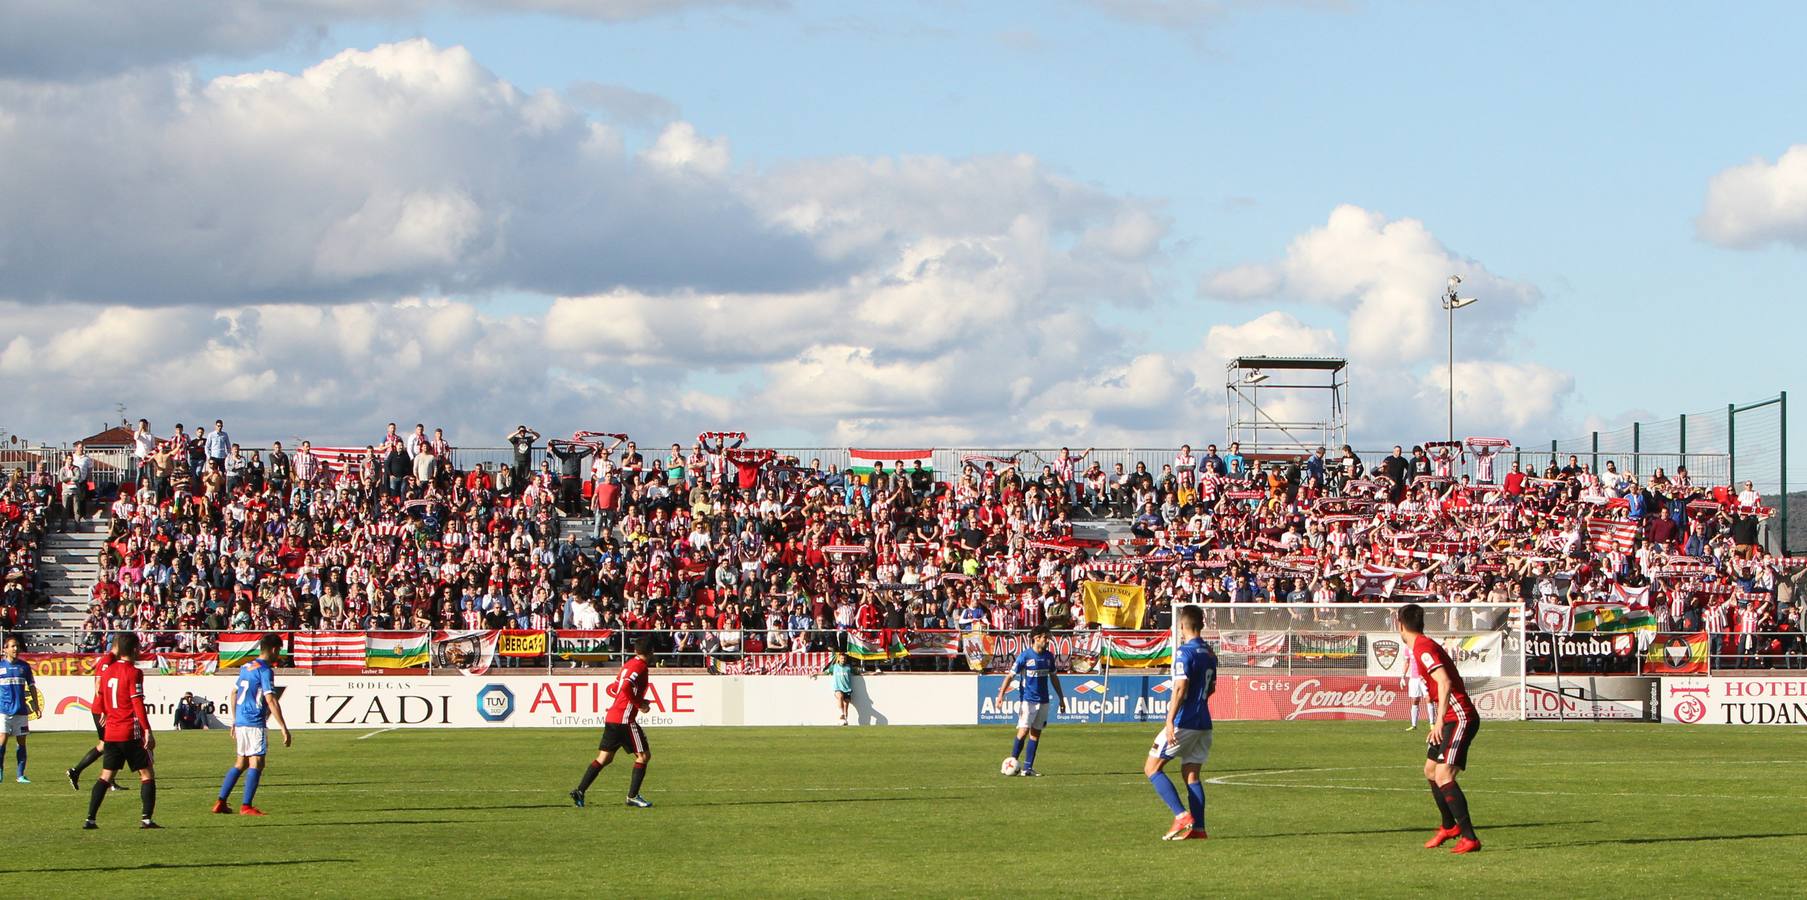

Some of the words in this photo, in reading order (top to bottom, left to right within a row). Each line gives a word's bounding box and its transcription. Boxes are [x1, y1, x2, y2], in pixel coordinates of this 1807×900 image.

[993, 633, 1073, 661] ARNDO
[1250, 680, 1290, 691] Cafés
[305, 695, 453, 724] IZADI
[1057, 697, 1125, 714] Alucoil
[1286, 679, 1396, 720] Gometero
[551, 716, 562, 725] Tu
[564, 716, 580, 725] ITV
[651, 716, 673, 725] Ebro
